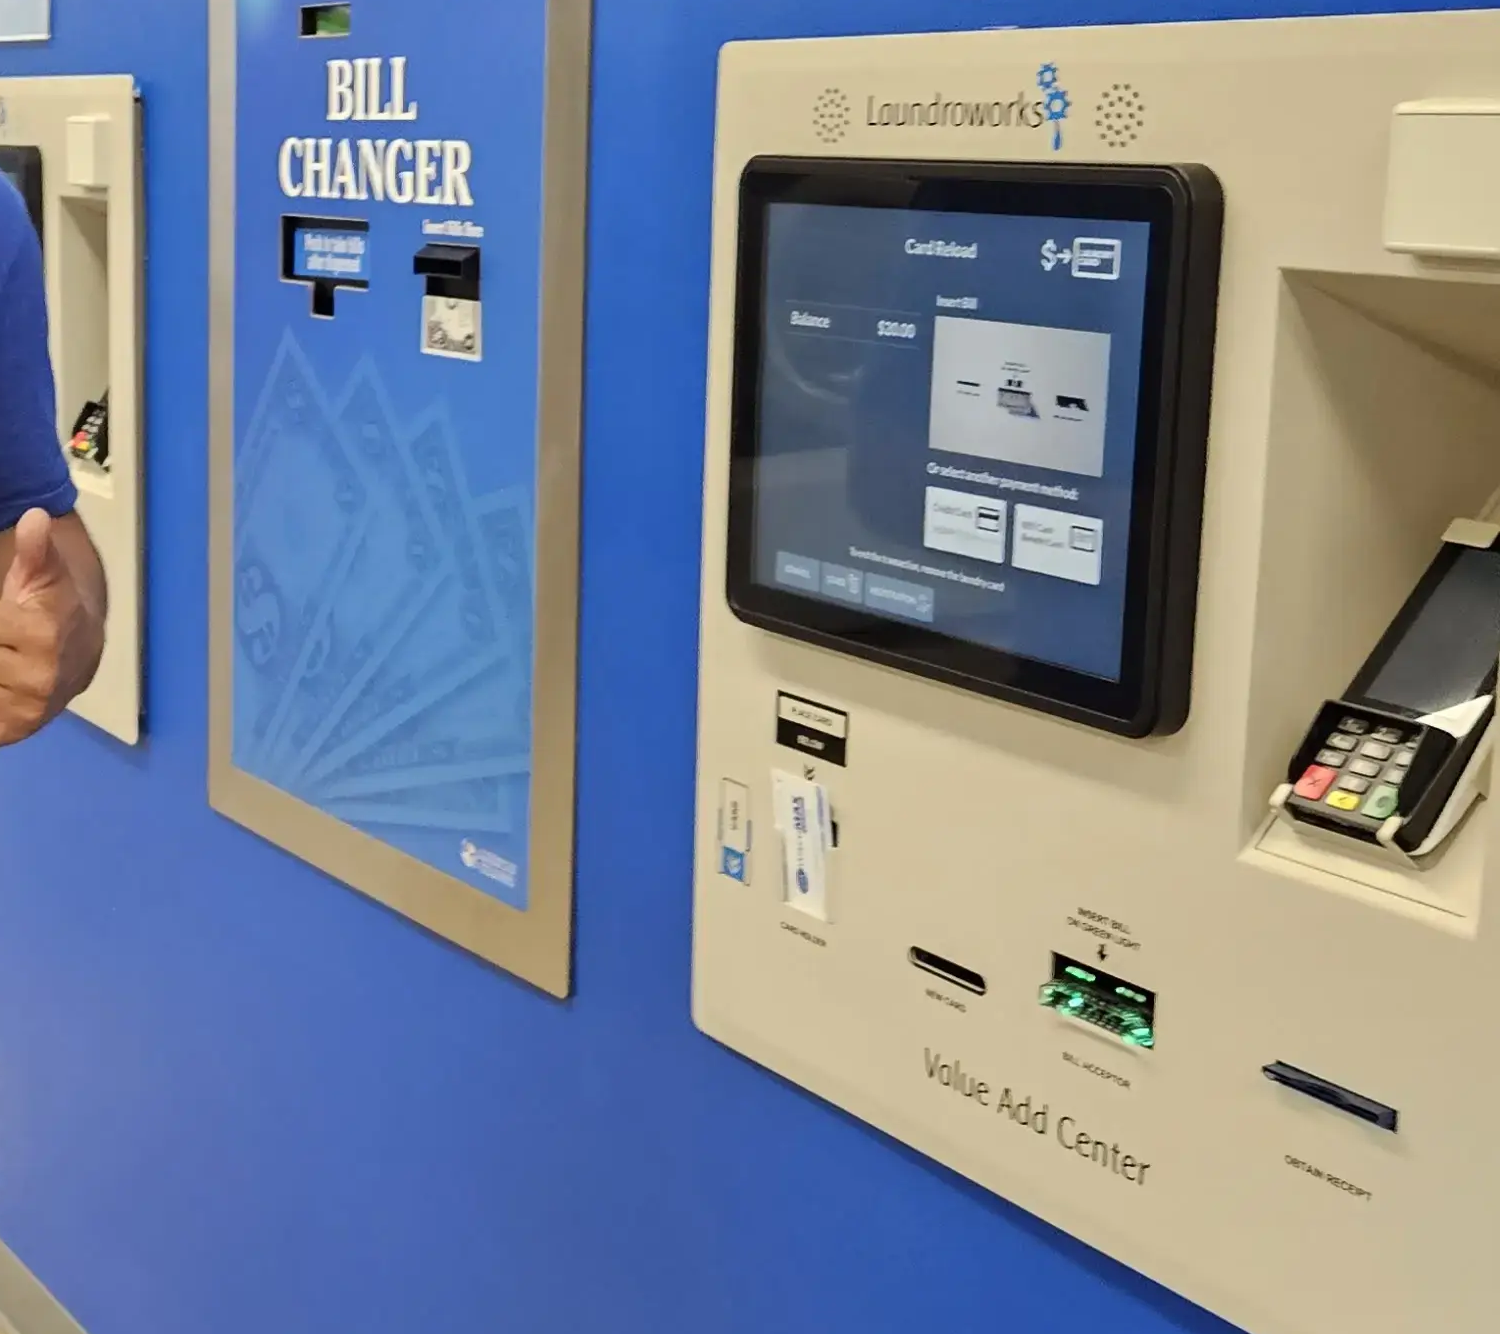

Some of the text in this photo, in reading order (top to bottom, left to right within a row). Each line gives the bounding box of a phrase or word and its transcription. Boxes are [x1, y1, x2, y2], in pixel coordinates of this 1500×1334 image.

[326, 56, 417, 121] BILL
[866, 91, 1044, 128] Laundroworks
[278, 137, 474, 206] CHANGER
[924, 1047, 1151, 1186] Value Add Center
[1284, 1154, 1372, 1202] OBTAIN RECEIPT
